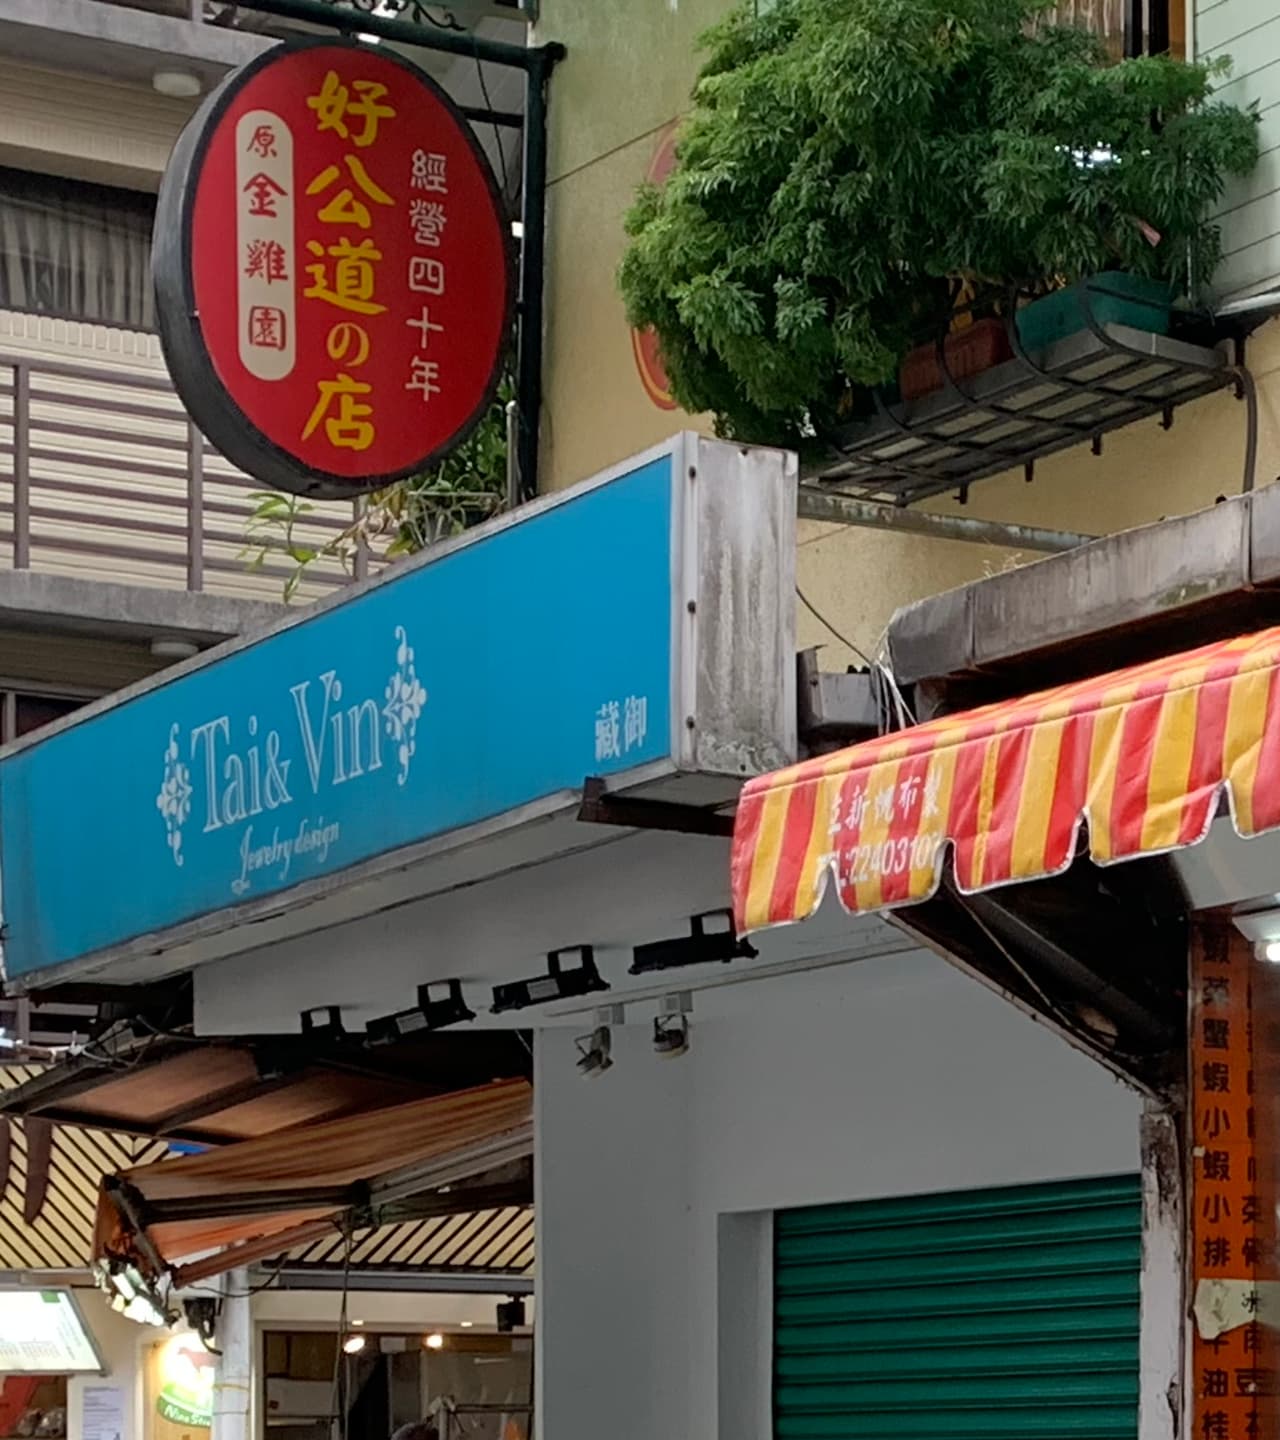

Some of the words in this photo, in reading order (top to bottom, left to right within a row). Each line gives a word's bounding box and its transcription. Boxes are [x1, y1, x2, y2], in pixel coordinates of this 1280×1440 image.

[243, 124, 289, 351] 原金雞園
[301, 69, 396, 452] 好公道の店
[405, 148, 449, 402] 經營四十年
[289, 669, 383, 794] Vin
[294, 815, 340, 864] design
